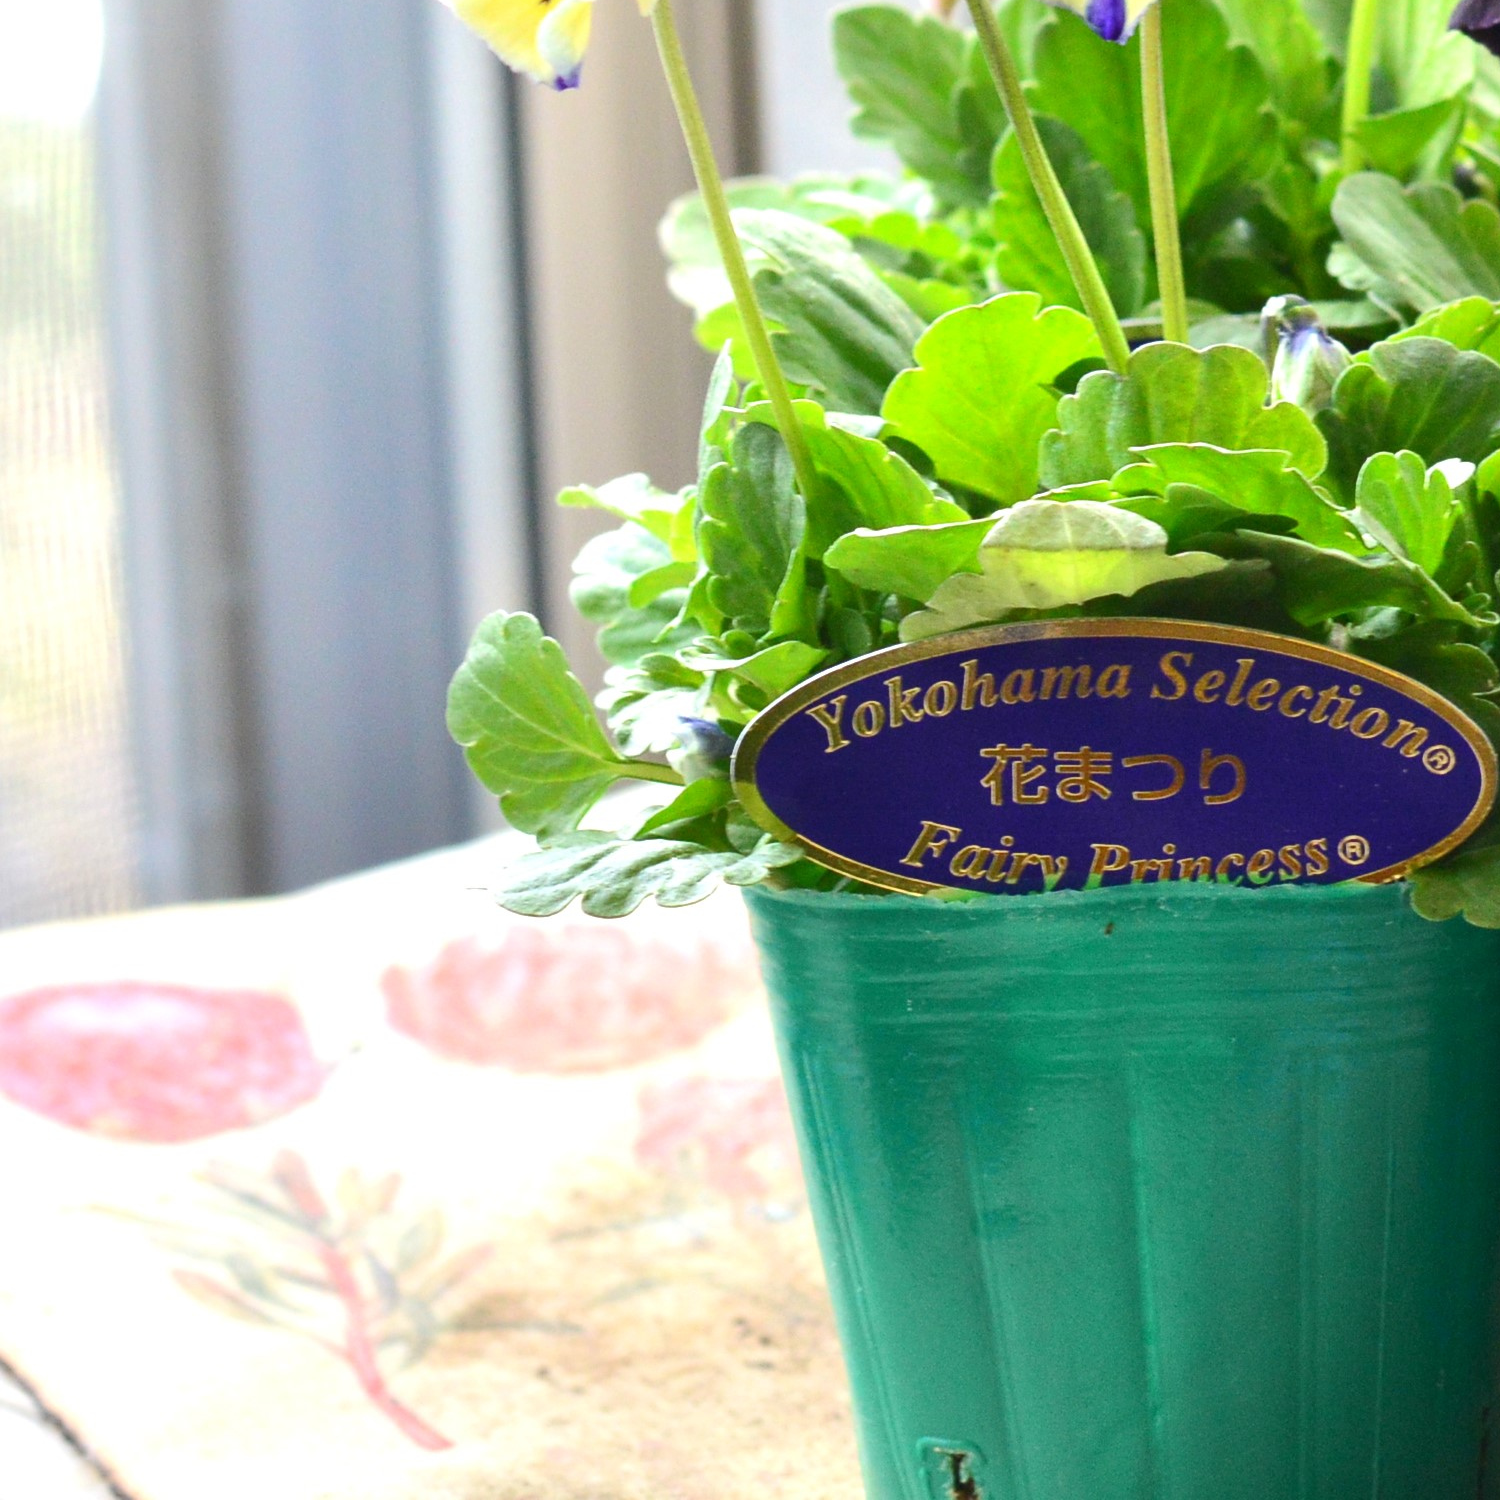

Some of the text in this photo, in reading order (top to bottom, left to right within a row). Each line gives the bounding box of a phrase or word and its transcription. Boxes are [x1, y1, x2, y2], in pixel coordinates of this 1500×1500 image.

[806, 656, 1132, 754] Yokohama
[979, 743, 1248, 808] 花まつり
[899, 819, 1069, 894] Fairy
